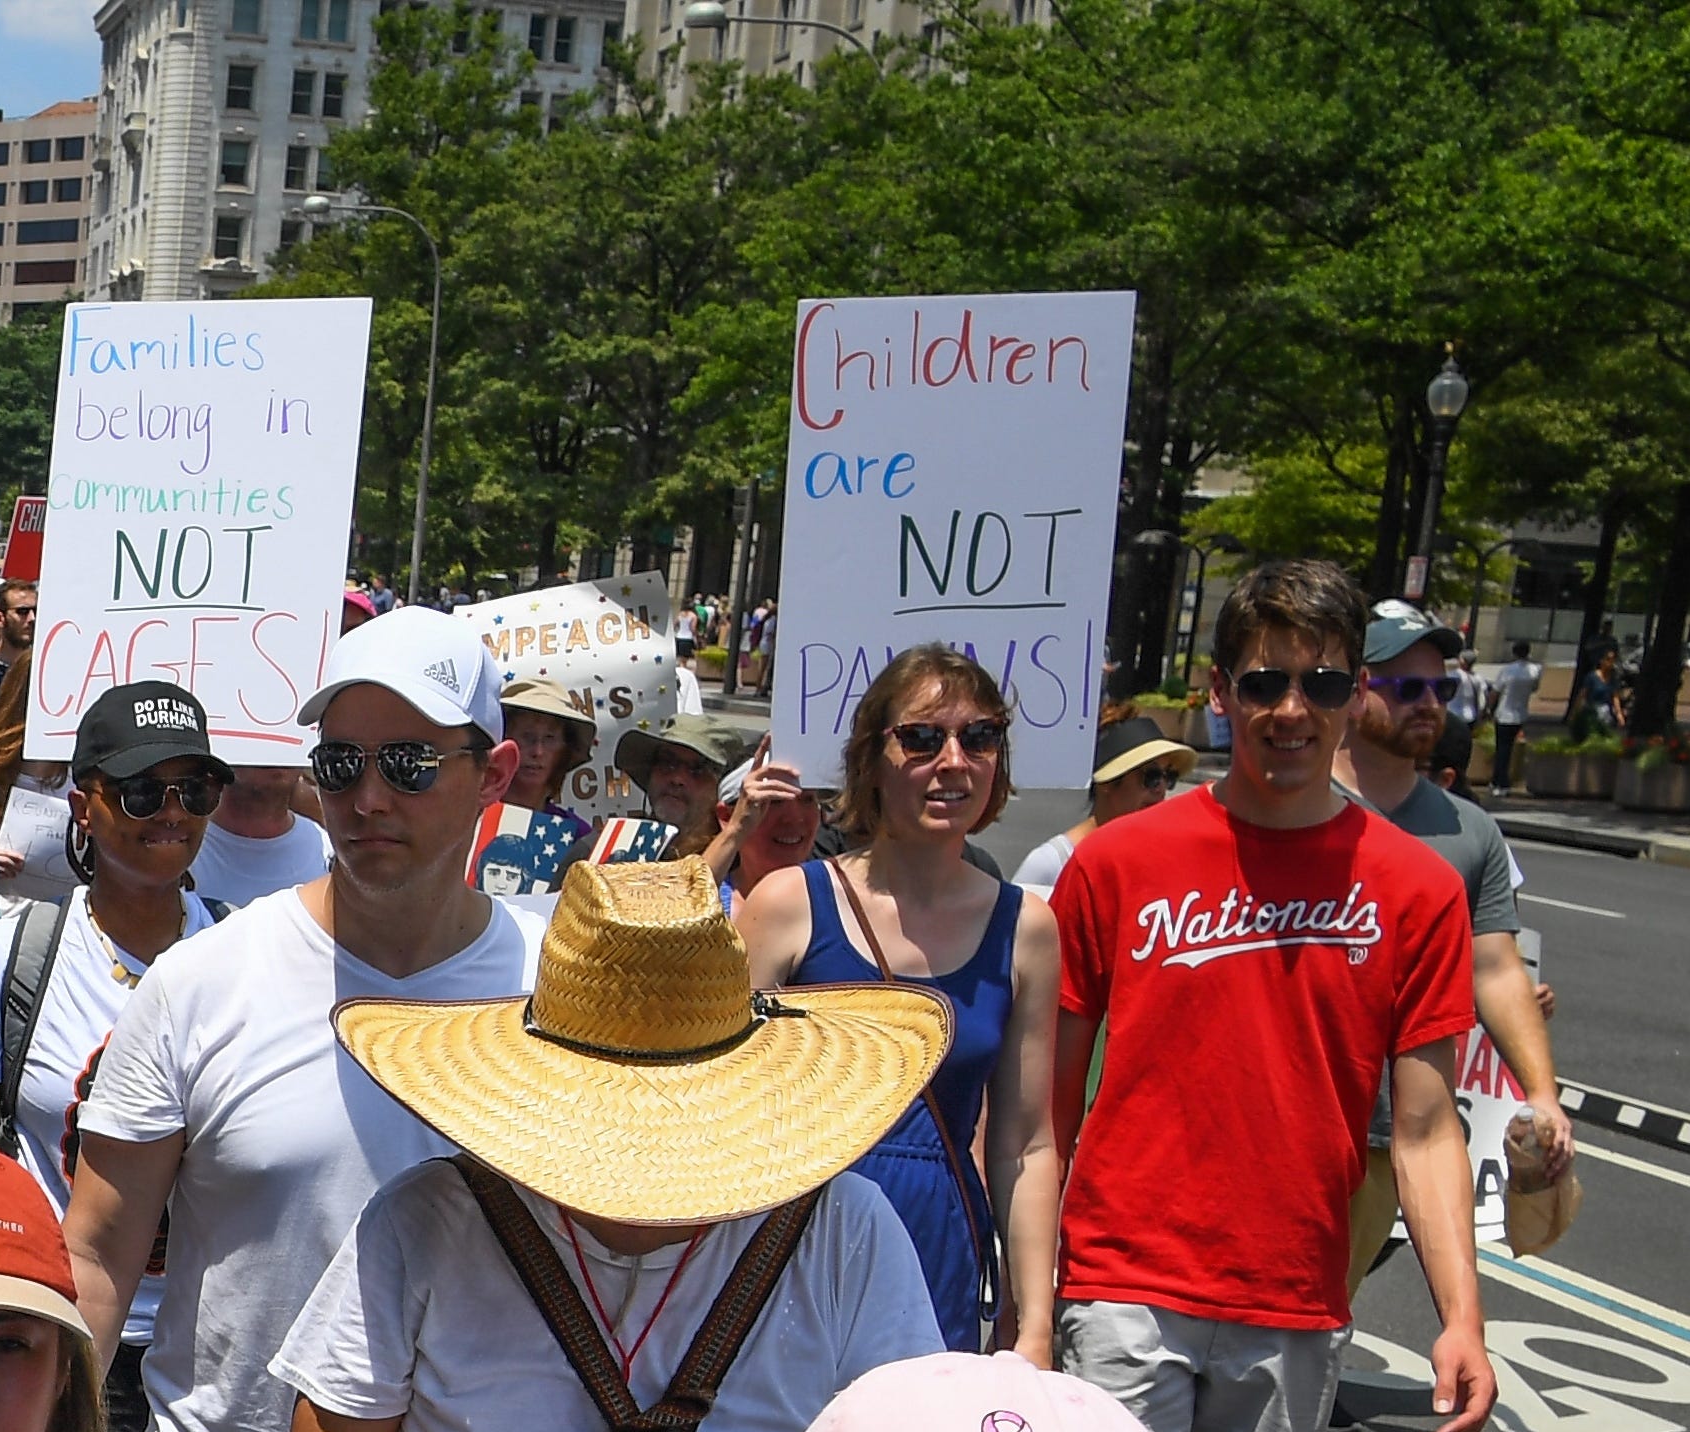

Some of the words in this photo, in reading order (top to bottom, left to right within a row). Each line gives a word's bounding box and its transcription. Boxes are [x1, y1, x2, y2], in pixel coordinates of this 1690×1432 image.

[69, 306, 265, 380] Families
[796, 304, 1090, 431] Children
[74, 391, 213, 475] belong
[264, 389, 314, 438] in
[804, 450, 917, 500] are
[19, 503, 45, 532] CHI
[897, 508, 1082, 598] NOT
[113, 525, 272, 605] NOT
[482, 605, 651, 661] MPEACH
[133, 700, 155, 714] DO
[157, 699, 170, 710] IT
[171, 699, 197, 719] LIKE
[800, 619, 1091, 736] PAS!
[135, 710, 199, 732] DURHAM
[1131, 881, 1382, 963] Nationals
